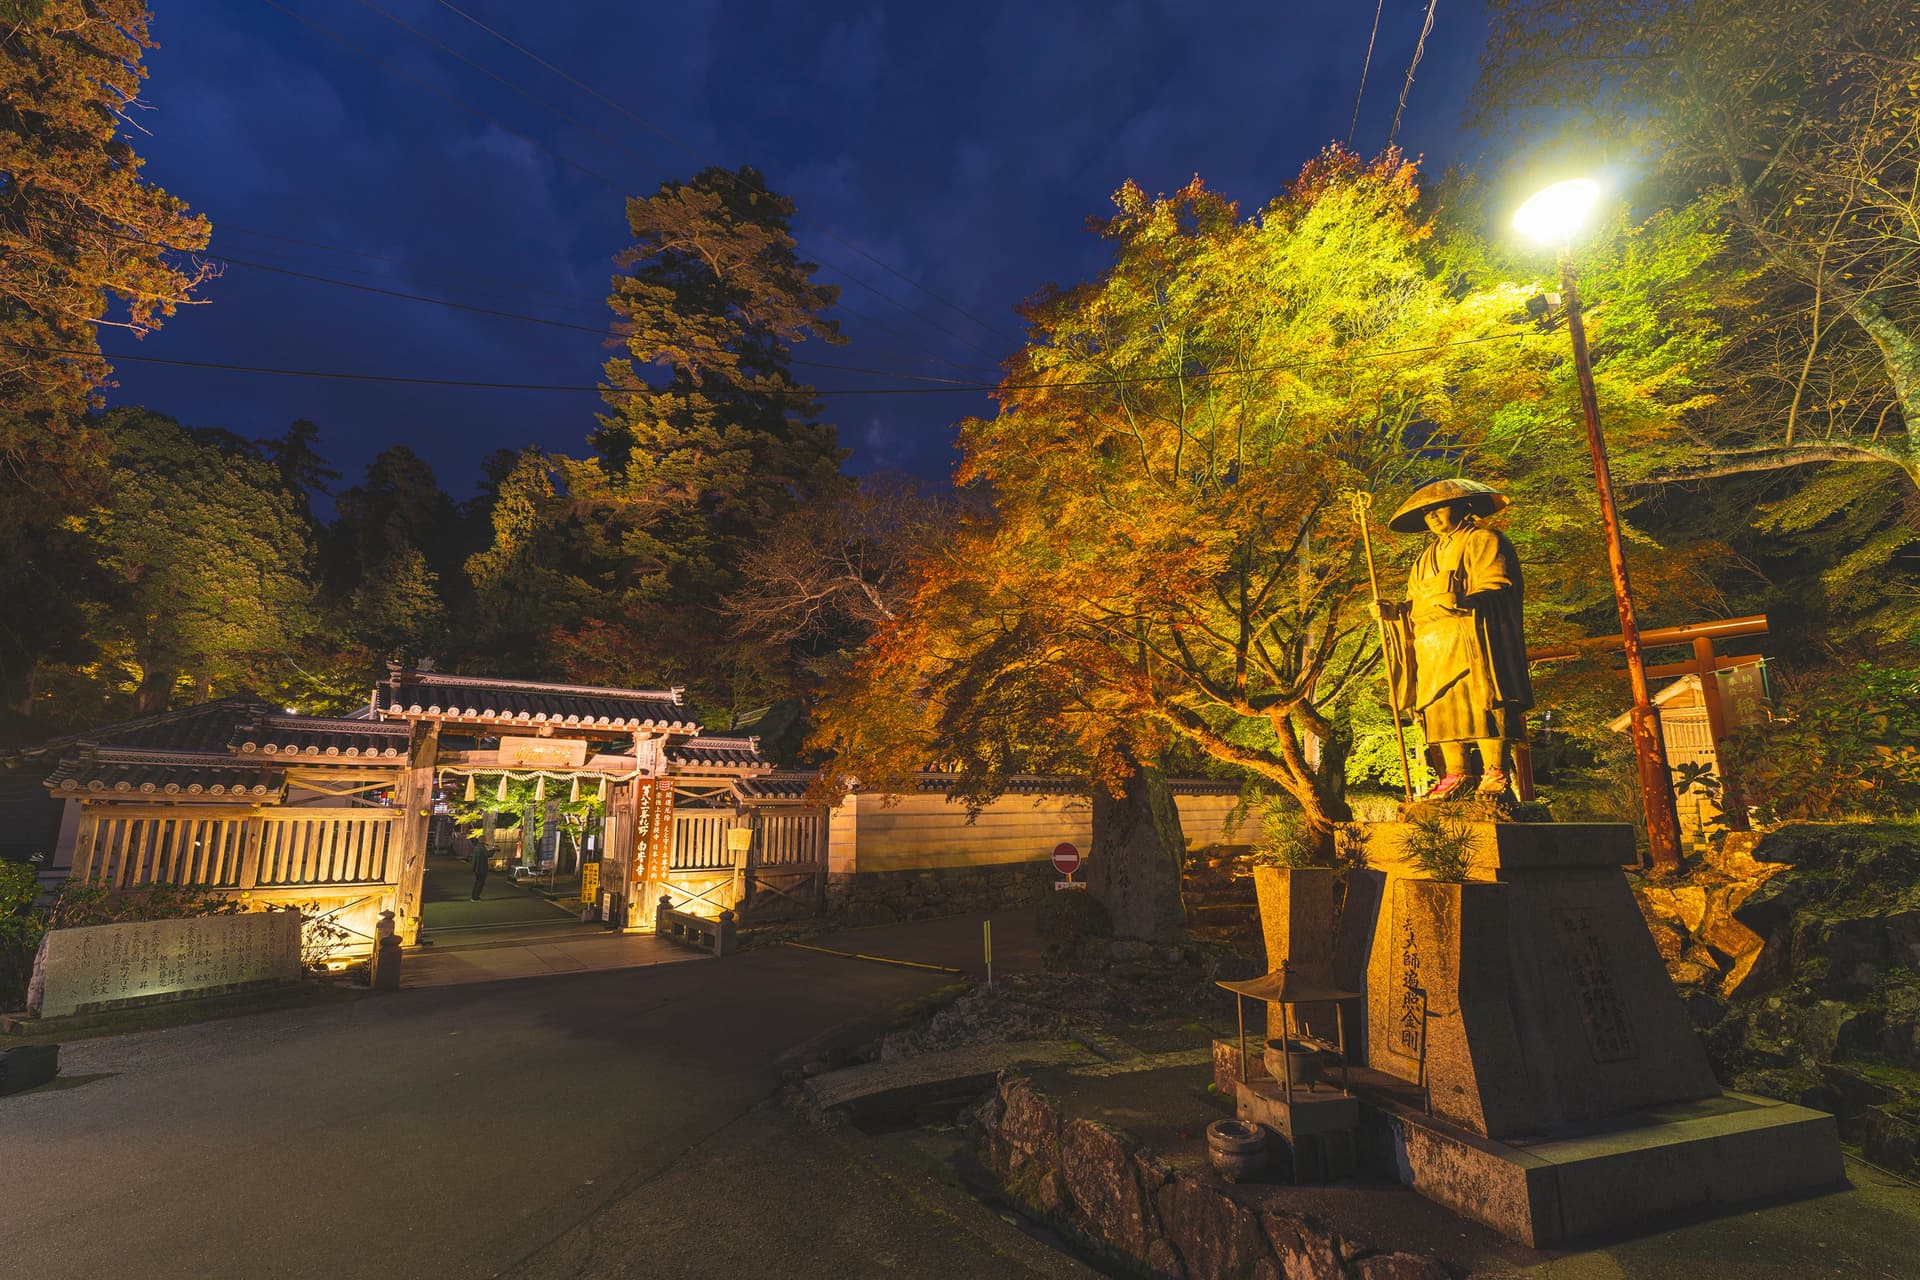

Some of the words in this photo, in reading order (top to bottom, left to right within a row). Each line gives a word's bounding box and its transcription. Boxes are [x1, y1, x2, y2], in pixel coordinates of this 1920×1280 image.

[1401, 902, 1421, 1052] 大師遍照金剛
